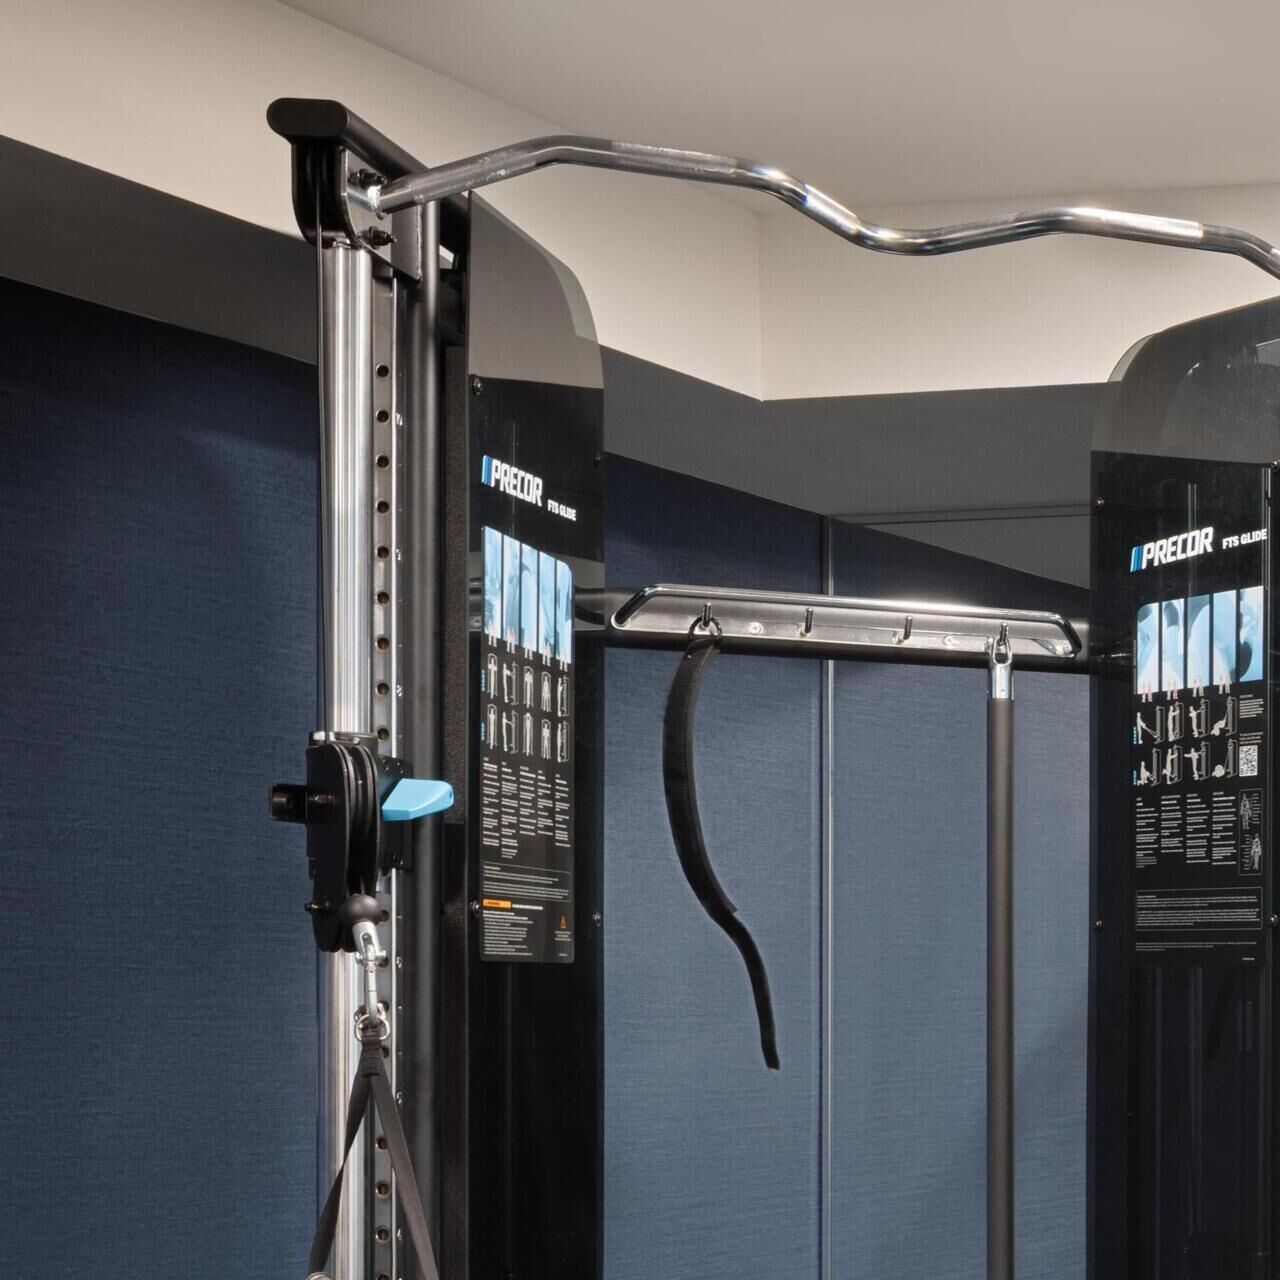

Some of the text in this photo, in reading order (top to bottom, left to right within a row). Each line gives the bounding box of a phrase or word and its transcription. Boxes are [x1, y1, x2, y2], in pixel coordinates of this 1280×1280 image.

[490, 458, 543, 507] PRECOR
[559, 504, 577, 522] GLIDE
[1141, 526, 1268, 570] PRECOR FTS GLIDE
